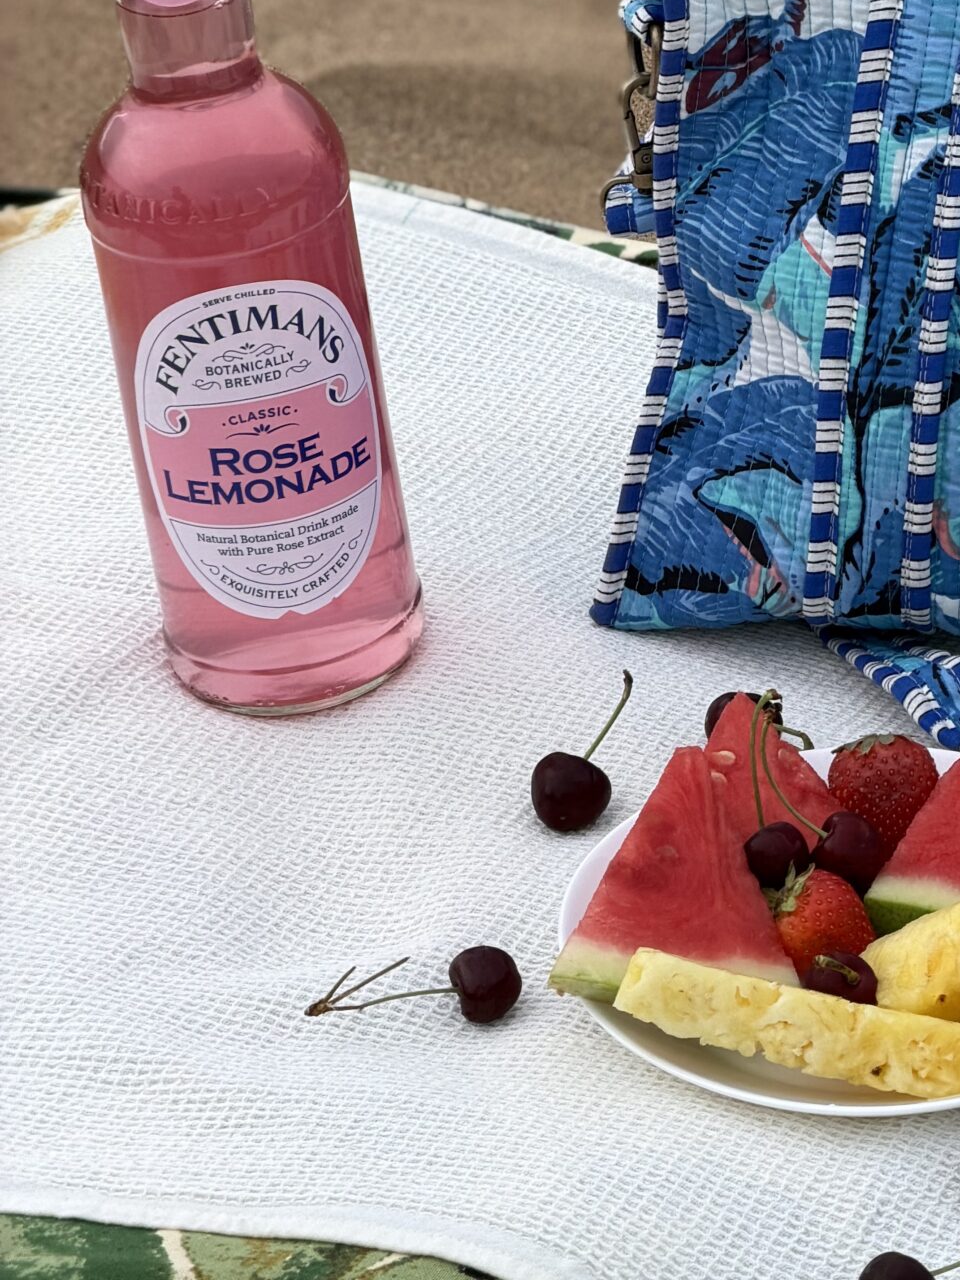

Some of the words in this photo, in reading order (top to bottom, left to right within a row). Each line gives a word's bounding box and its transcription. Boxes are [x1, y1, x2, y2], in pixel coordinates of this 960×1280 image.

[203, 295, 232, 308] SERVE
[235, 288, 276, 301] CHILLED
[155, 304, 344, 396] FENTIMANS
[205, 351, 295, 376] BOTANICALLY
[225, 370, 282, 389] BREWED
[228, 405, 292, 426] CLASSIC
[163, 437, 371, 506] LEMONADE
[208, 433, 324, 476] ROSE
[197, 532, 238, 545] Natural
[240, 528, 295, 545] Botanical
[298, 519, 329, 536] Drink
[331, 504, 359, 525] made
[218, 545, 245, 558] with
[246, 544, 274, 556] Pure
[277, 538, 304, 553] Rose
[307, 525, 345, 548] Extract
[220, 574, 299, 600] EXQUISITELY
[302, 552, 351, 593] CRAFTED
